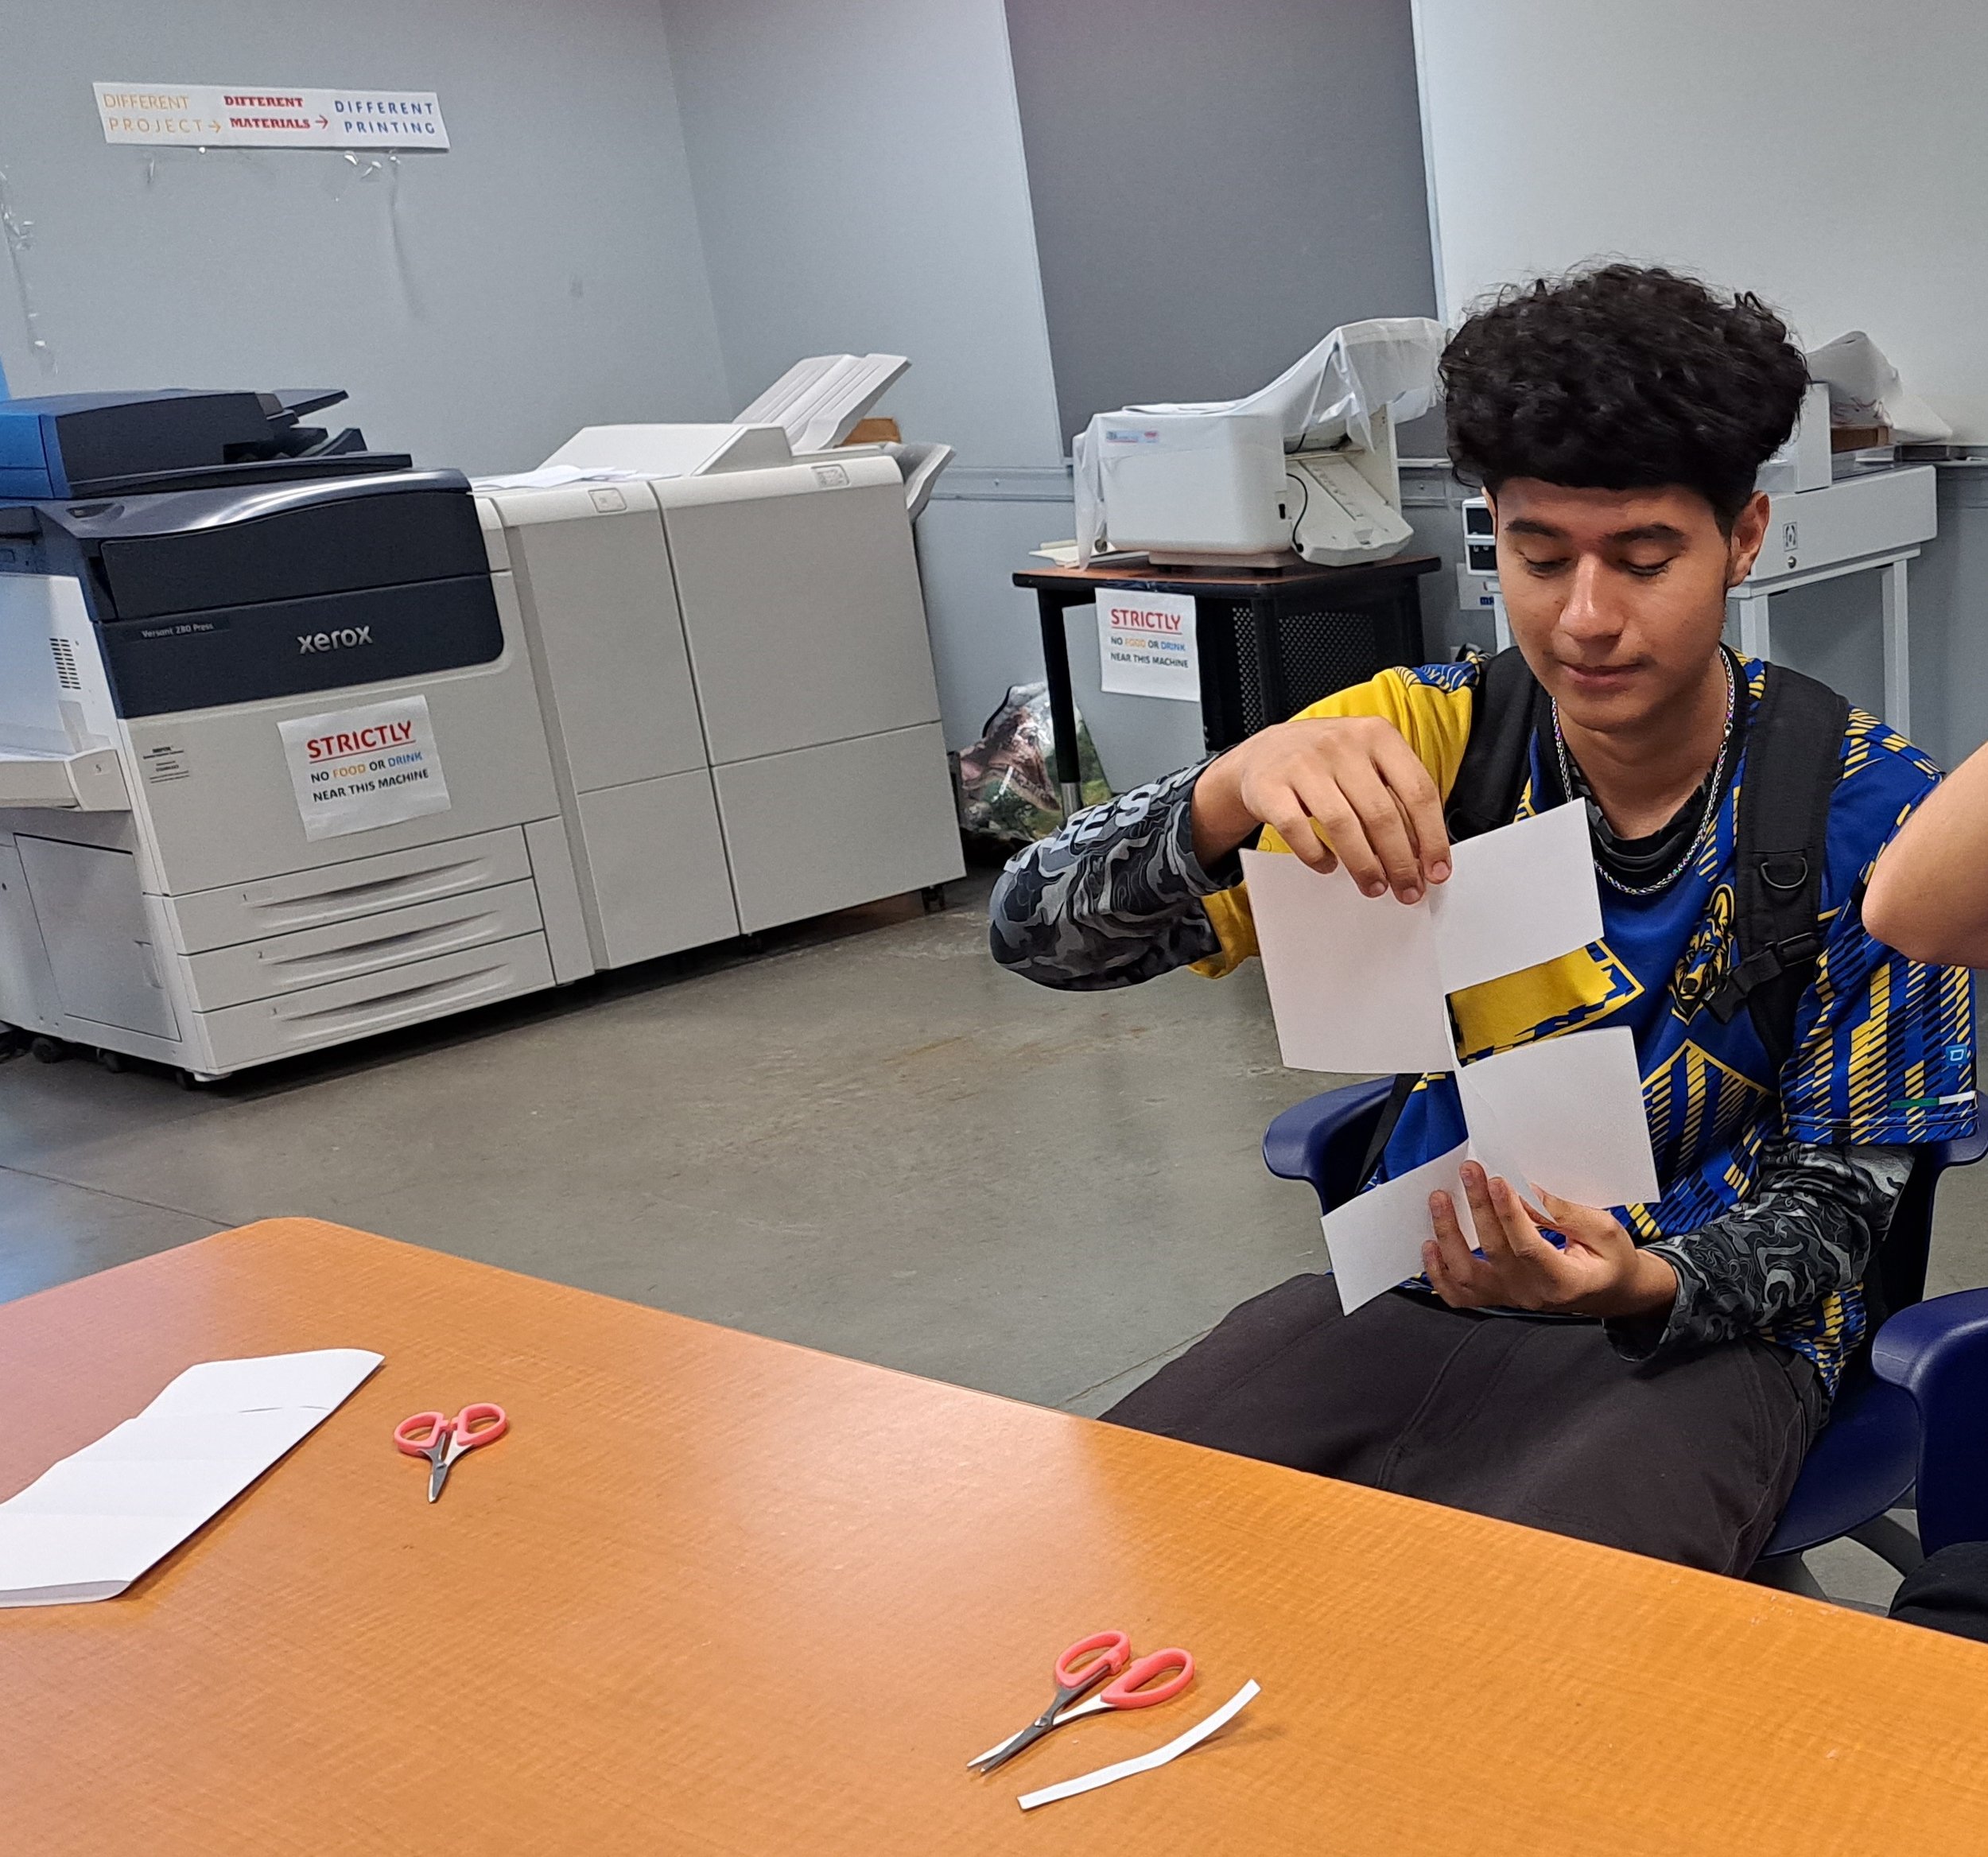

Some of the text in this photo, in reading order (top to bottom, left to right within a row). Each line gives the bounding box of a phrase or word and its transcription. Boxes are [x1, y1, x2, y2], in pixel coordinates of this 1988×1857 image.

[103, 93, 189, 110] DIFFERENT
[223, 95, 304, 108] DIFFERENT
[334, 99, 434, 115] DIFFERENT
[109, 118, 204, 134] PROJECT
[229, 117, 311, 130] MATERIALS
[344, 121, 436, 134] PRINTING
[1110, 608, 1181, 631] STRICTLY
[142, 627, 173, 638] Versant
[192, 623, 214, 631] Press
[297, 625, 374, 655] xerox
[1110, 636, 1186, 651] NO FOOD OR DRINK
[1110, 652, 1189, 668] NEAR THIS MACHINE
[306, 721, 412, 759] STRICTLY
[310, 752, 424, 783] NO FOOD OR DRINK
[313, 768, 429, 802] NEAR THIS MACHINE
